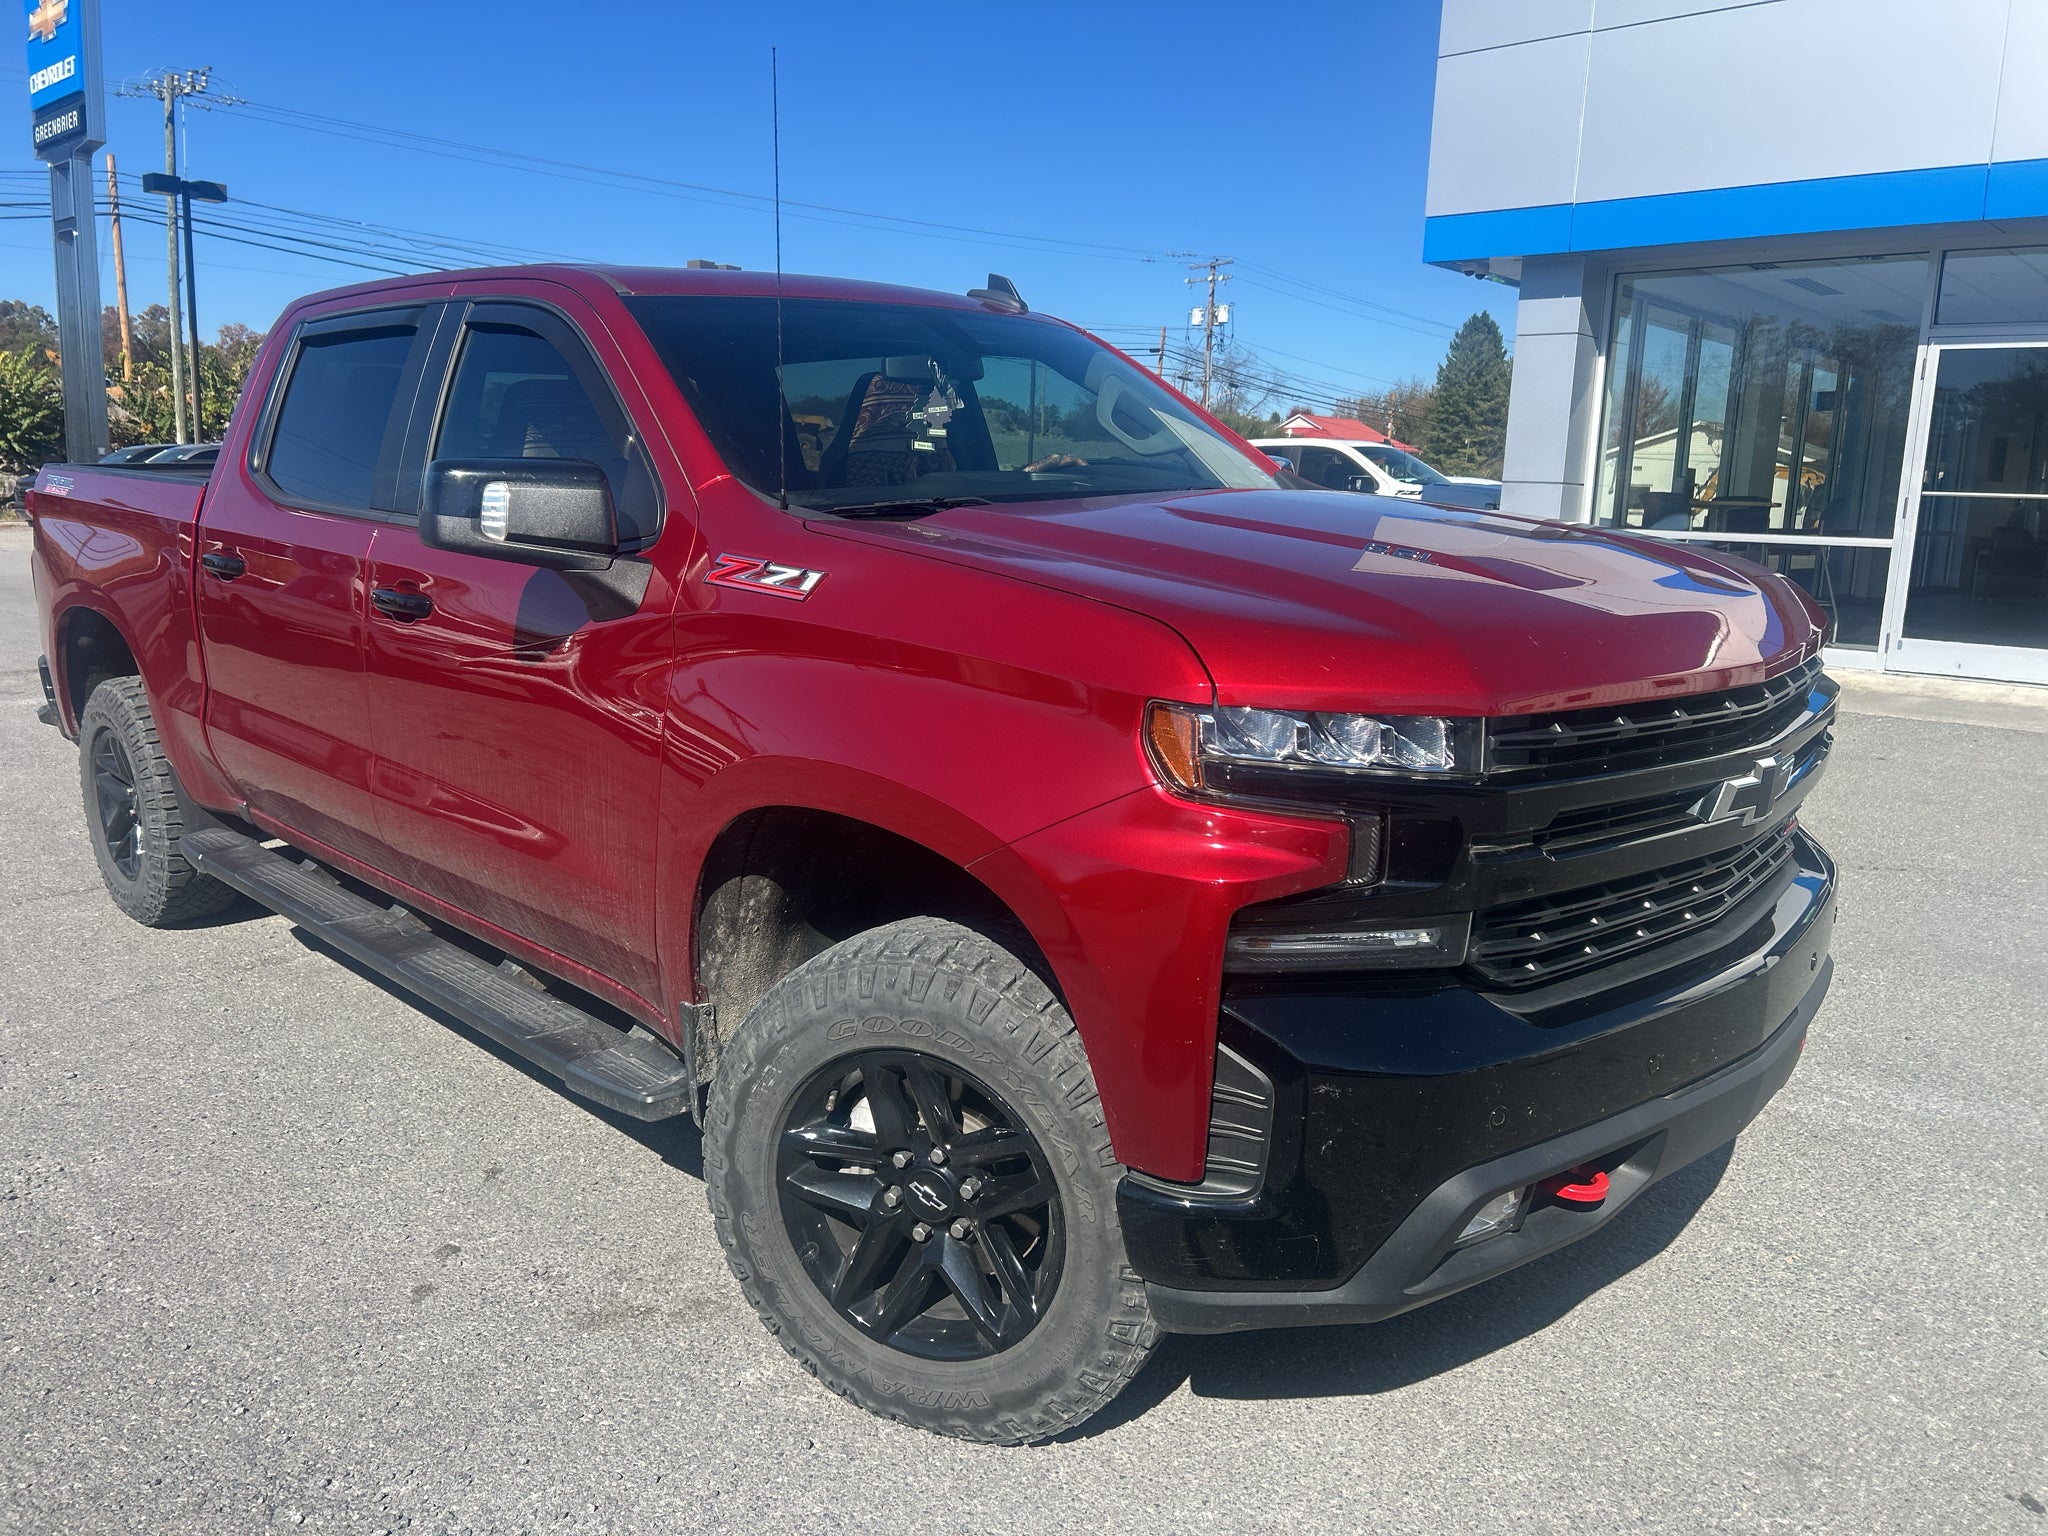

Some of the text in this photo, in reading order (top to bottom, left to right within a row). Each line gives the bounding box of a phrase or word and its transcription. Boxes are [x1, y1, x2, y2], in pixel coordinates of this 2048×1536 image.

[30, 55, 76, 95] CHEVROLET
[35, 110, 78, 143] GREENBRIER
[702, 552, 826, 602] Z71
[826, 1015, 1096, 1225] GOODYEAR
[740, 1211, 991, 1410] WRANGLER
